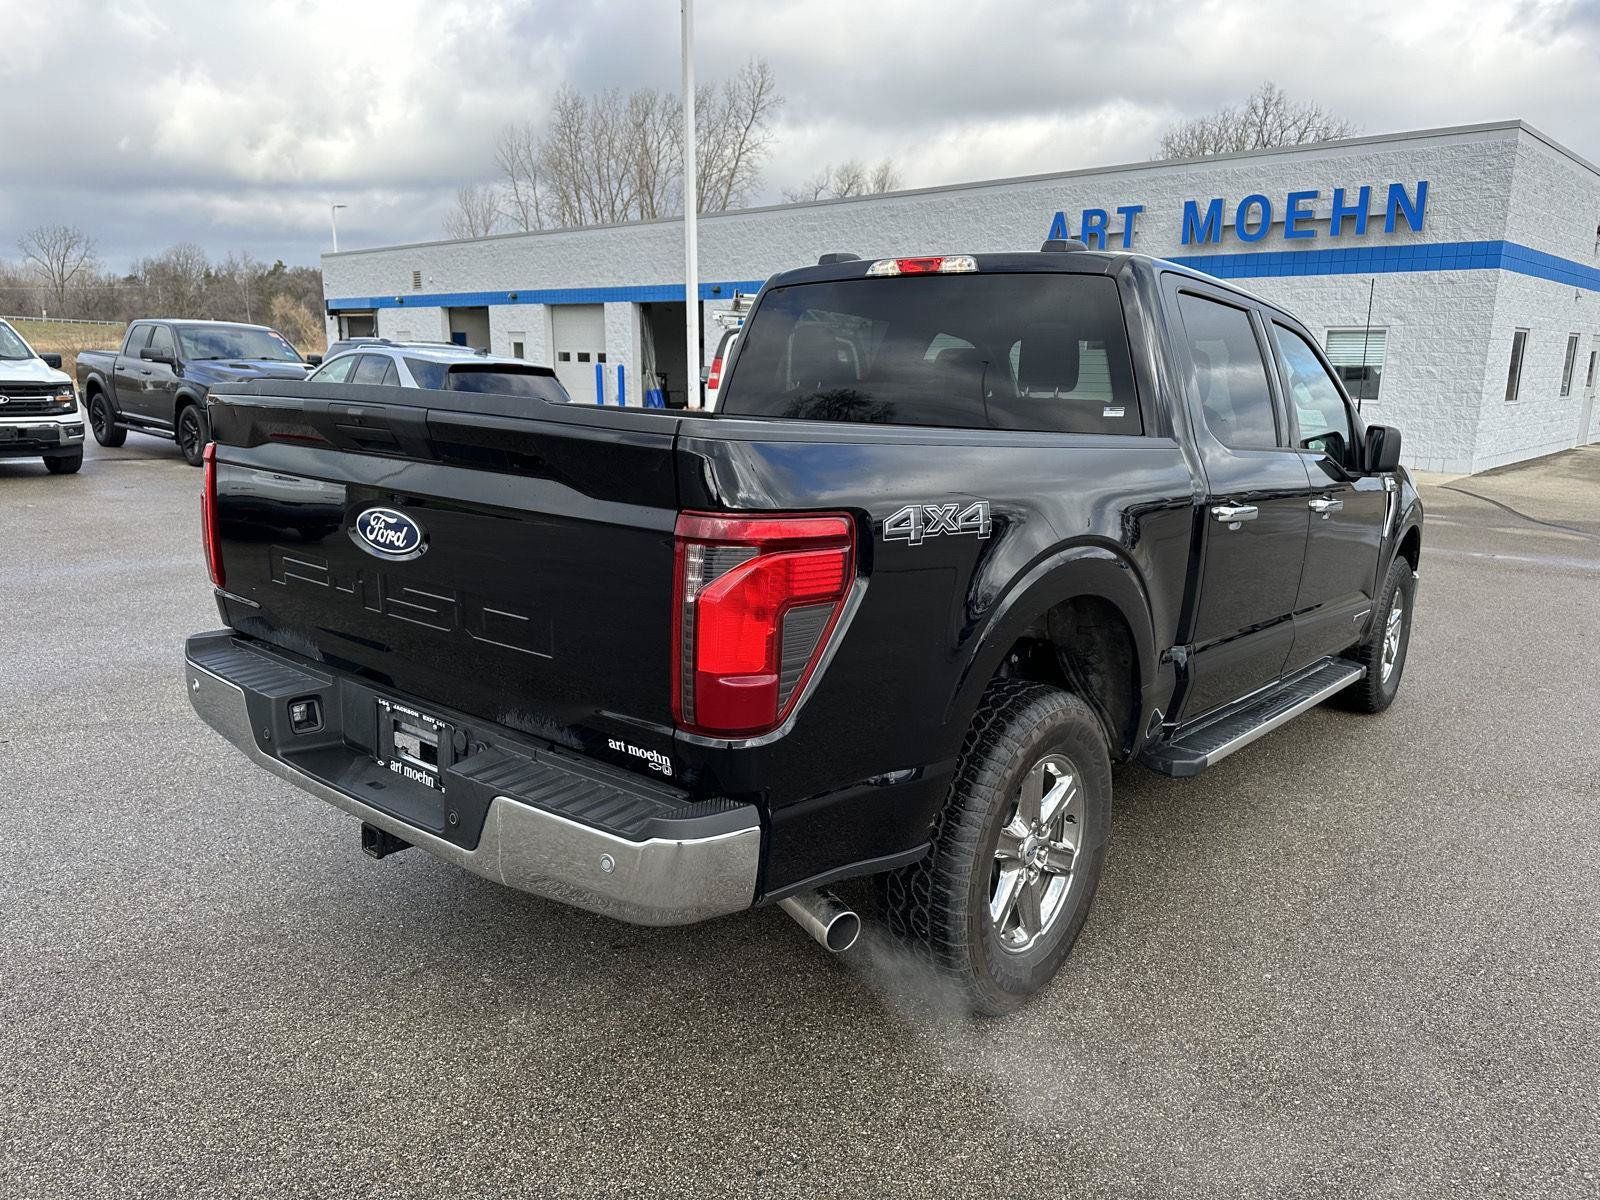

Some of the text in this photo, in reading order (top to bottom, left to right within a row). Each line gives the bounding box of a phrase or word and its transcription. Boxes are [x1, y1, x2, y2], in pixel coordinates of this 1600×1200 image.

[1047, 181, 1430, 249] ART MOEHN
[366, 512, 408, 548] Ford
[608, 738, 671, 767] art moehn
[390, 760, 435, 789] art moehn
